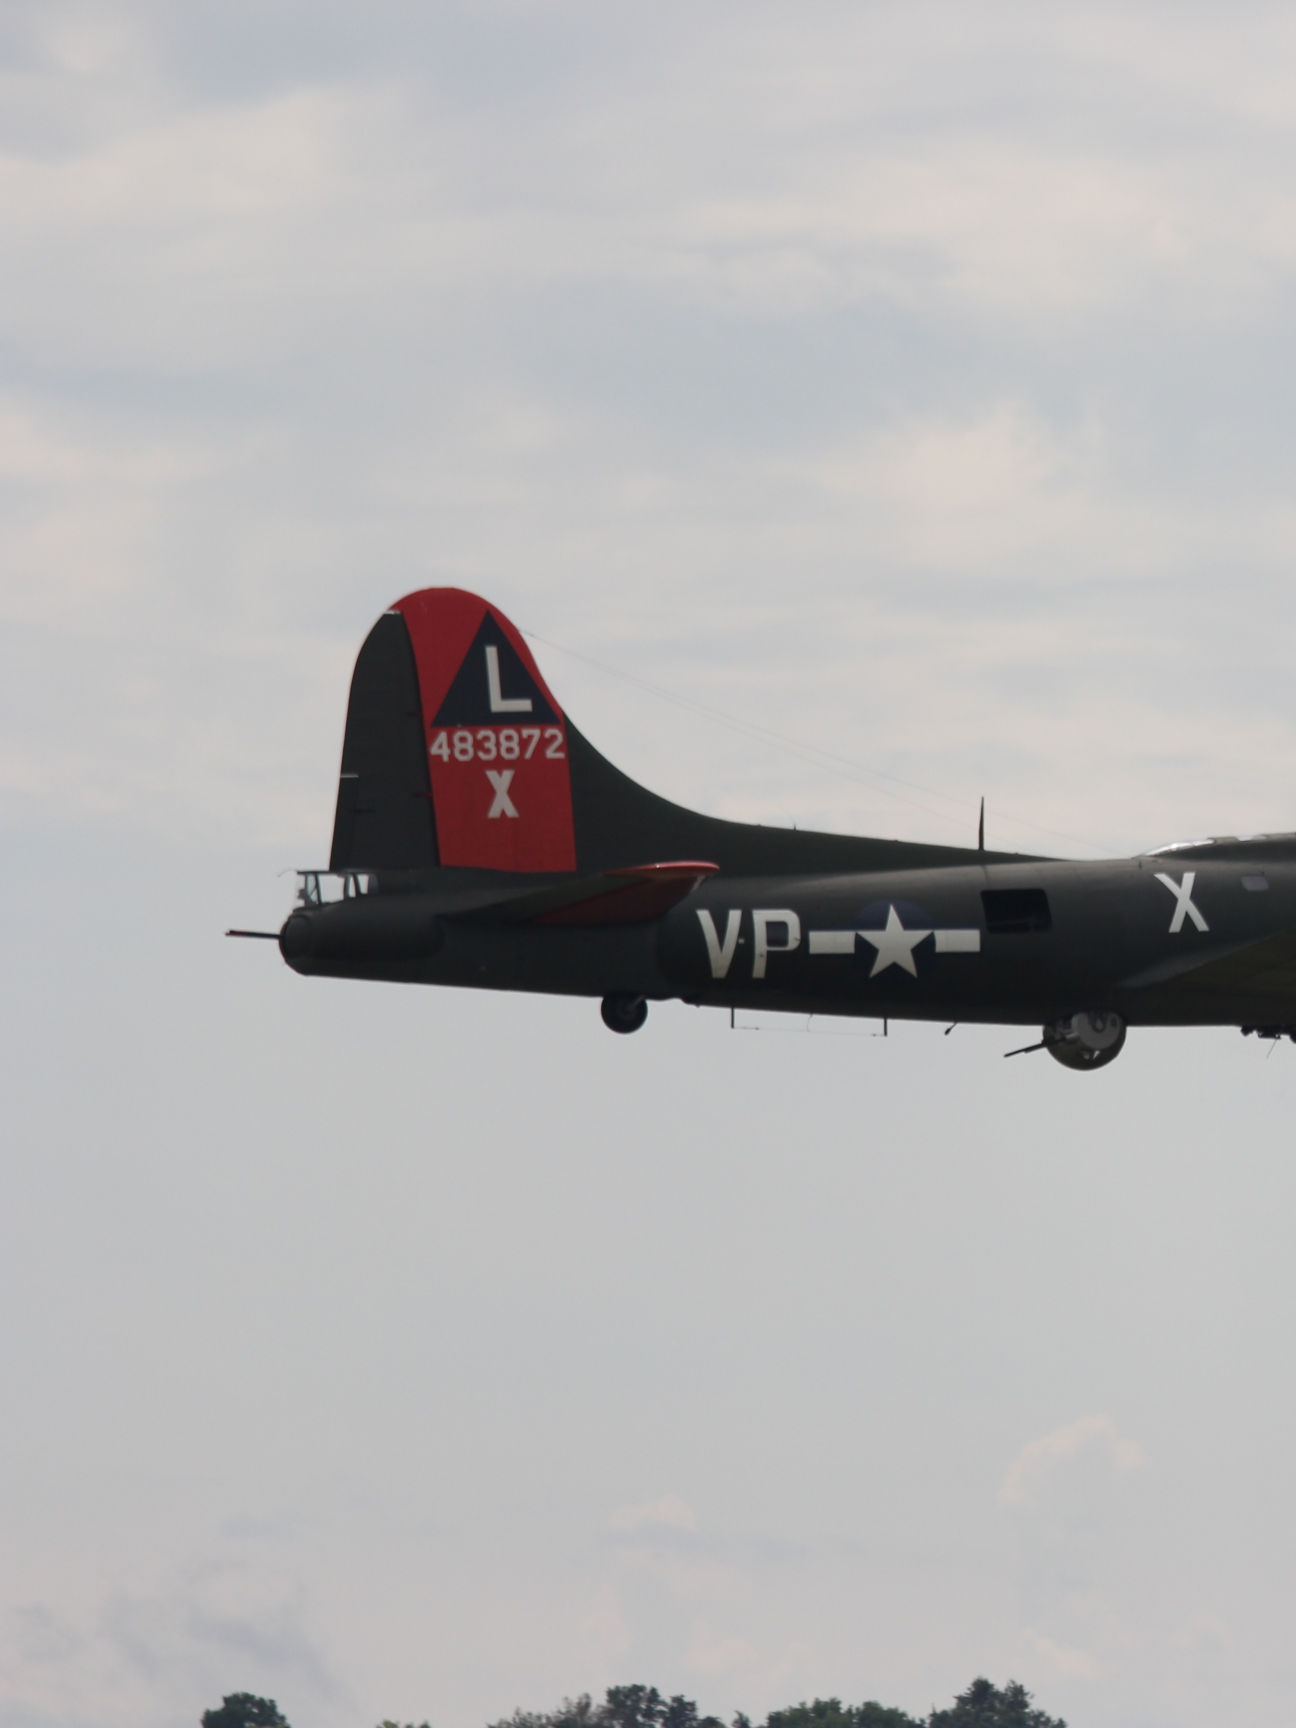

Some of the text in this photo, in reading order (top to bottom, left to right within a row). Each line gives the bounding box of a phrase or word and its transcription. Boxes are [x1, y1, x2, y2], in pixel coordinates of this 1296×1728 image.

[485, 646, 533, 712] L
[430, 728, 565, 762] 483872
[485, 769, 519, 818] X
[1153, 871, 1209, 933] X
[696, 909, 800, 978] VP
